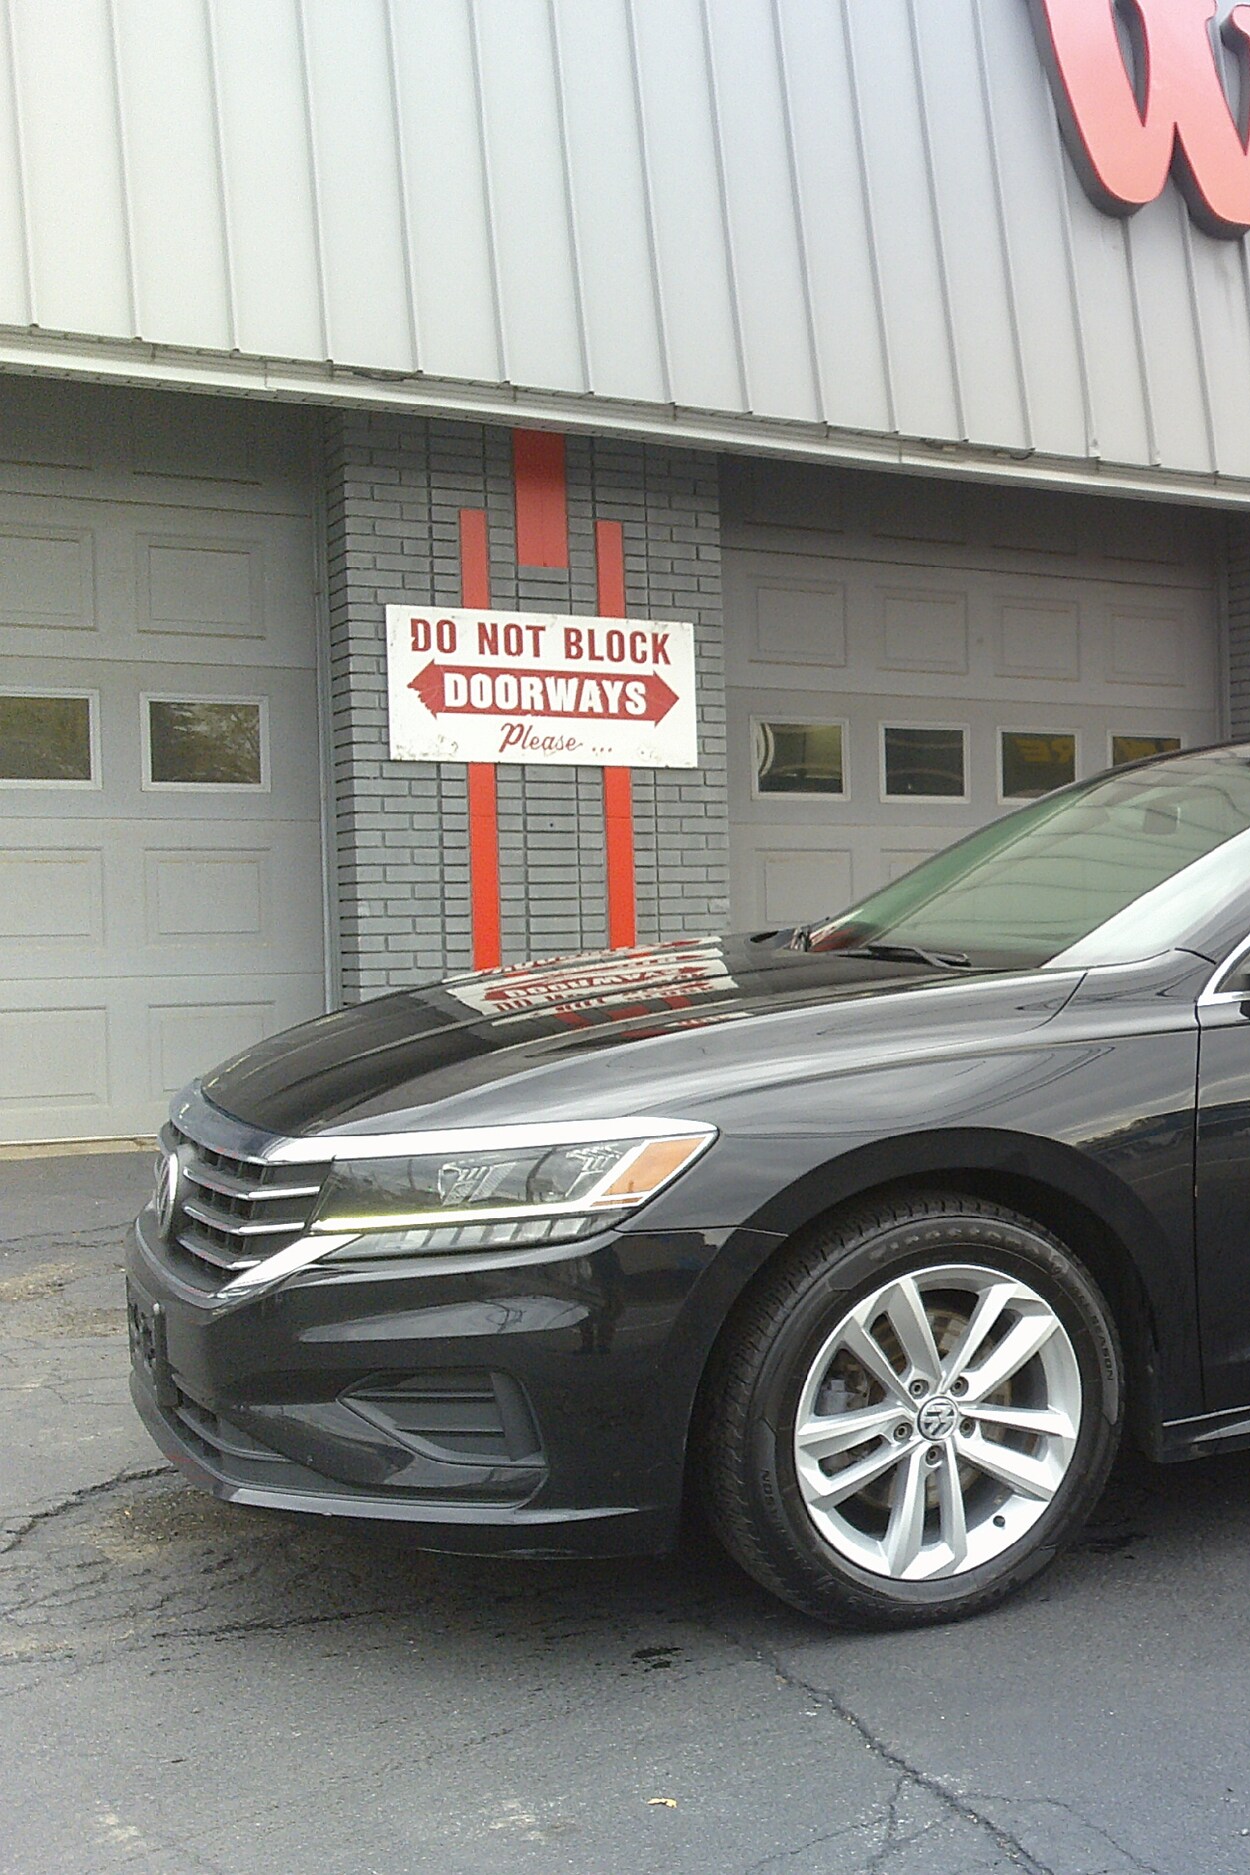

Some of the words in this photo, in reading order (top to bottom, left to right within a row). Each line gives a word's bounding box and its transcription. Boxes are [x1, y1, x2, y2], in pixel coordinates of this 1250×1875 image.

[410, 617, 457, 654] DO
[478, 621, 546, 658] NOT
[563, 627, 672, 666] BLOCK
[442, 672, 648, 717] DOORWAYS
[498, 722, 584, 753] Please
